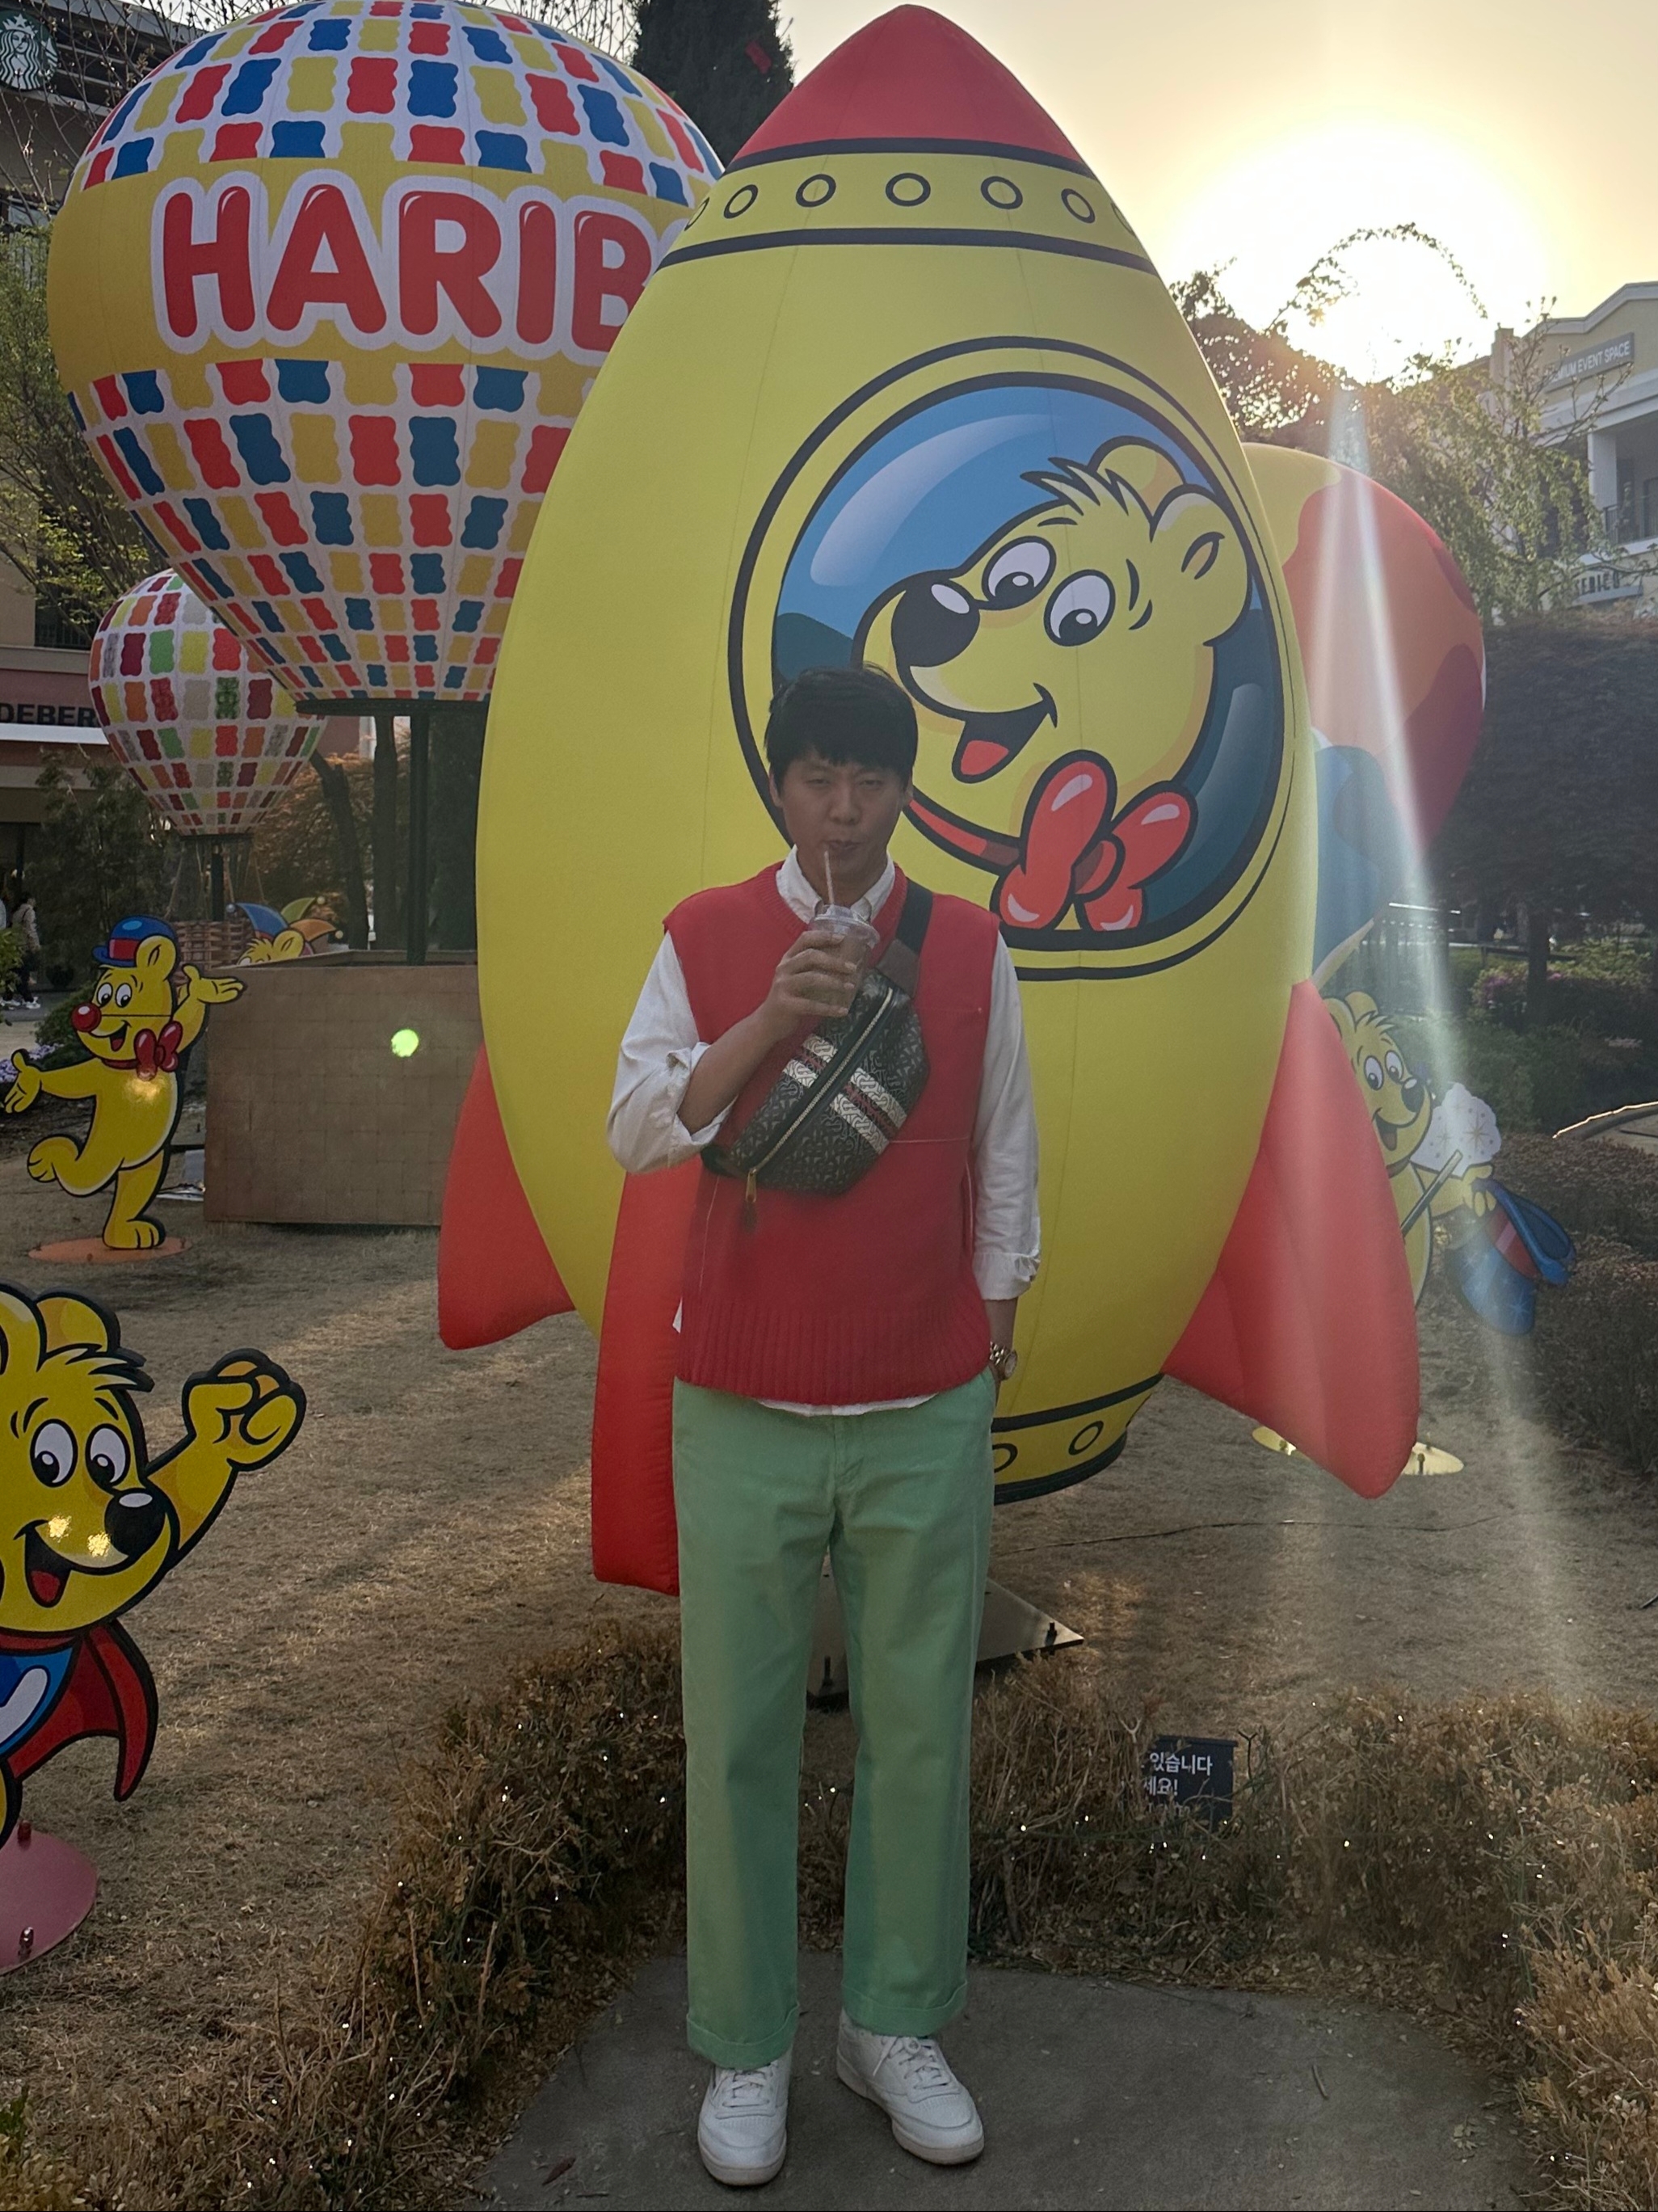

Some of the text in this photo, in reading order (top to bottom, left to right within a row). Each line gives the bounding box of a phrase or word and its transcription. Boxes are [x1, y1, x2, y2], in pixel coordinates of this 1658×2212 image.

[163, 183, 652, 352] HARIB
[1577, 351, 1603, 373] EVENT
[1604, 340, 1631, 363] SPACE
[0, 702, 99, 727] DEBER
[1149, 1751, 1214, 1776] 있습니다
